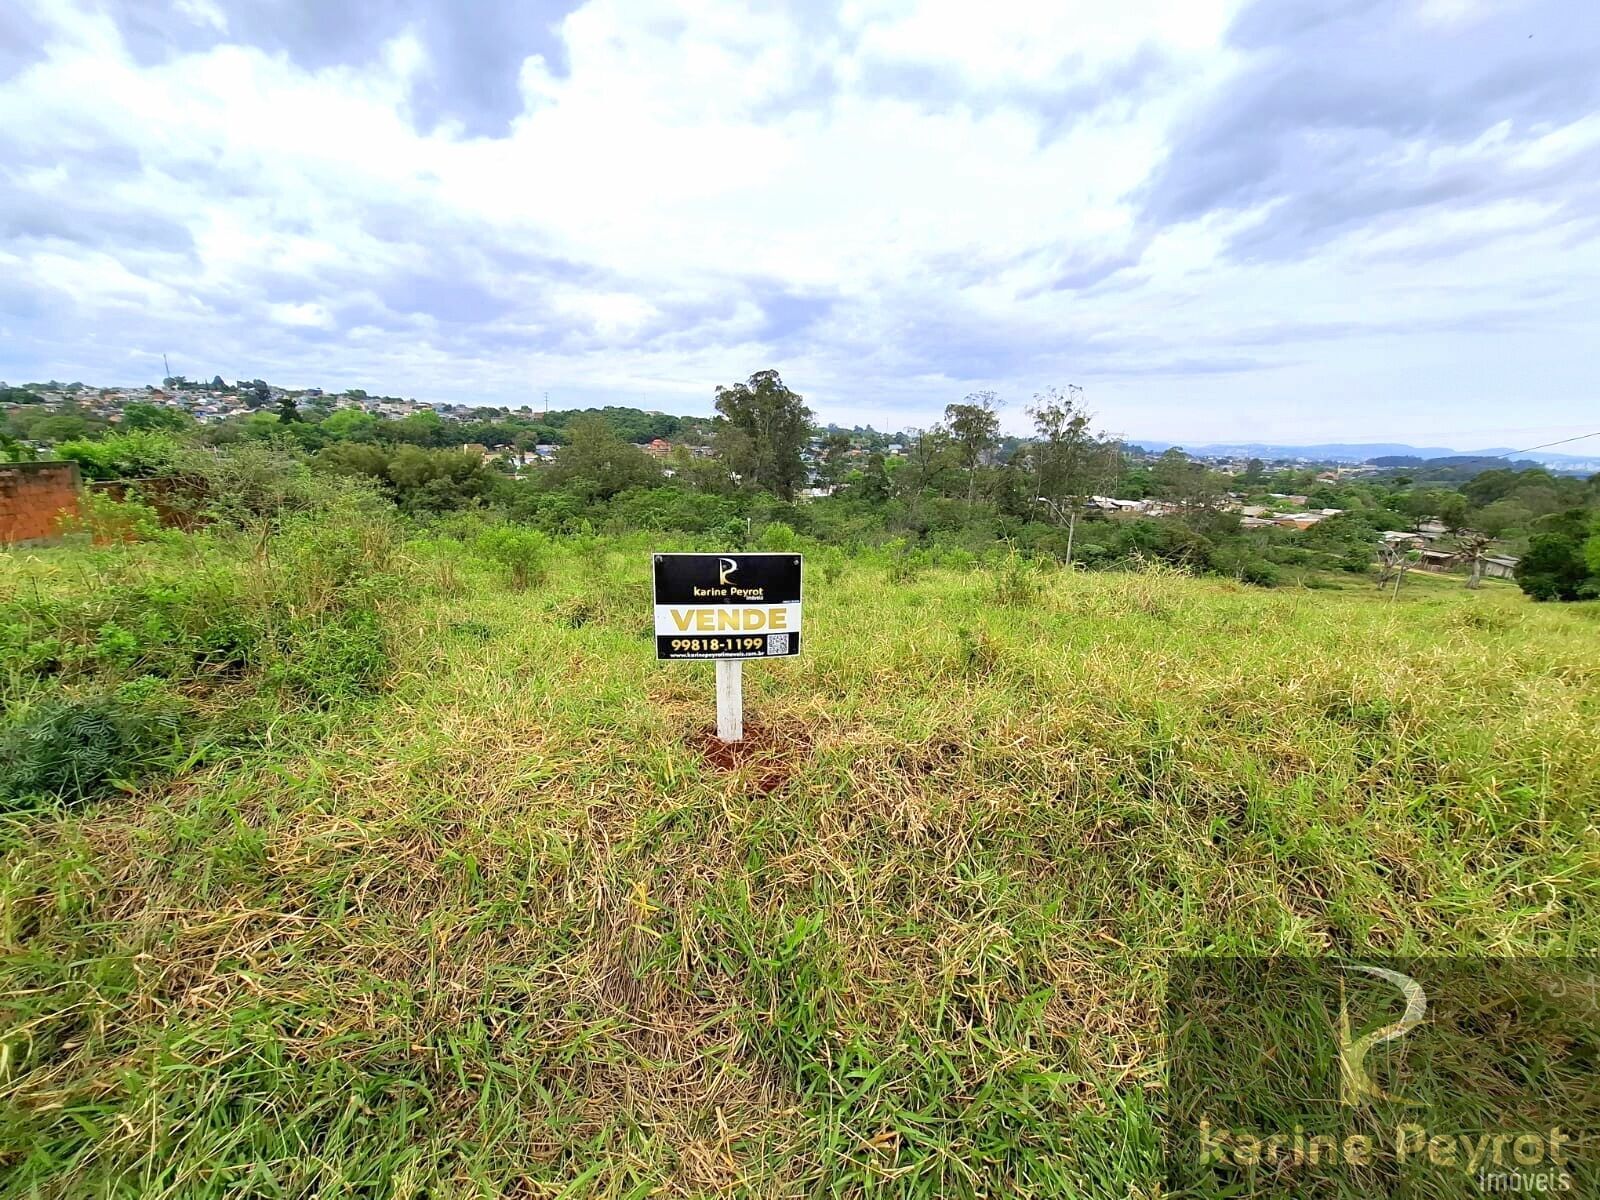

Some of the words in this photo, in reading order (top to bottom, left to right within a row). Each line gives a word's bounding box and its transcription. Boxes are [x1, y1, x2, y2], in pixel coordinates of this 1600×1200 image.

[693, 586, 727, 596] karine
[730, 587, 764, 598] Peyrot
[670, 608, 787, 631] VENDE
[671, 638, 763, 650] 99818-1199
